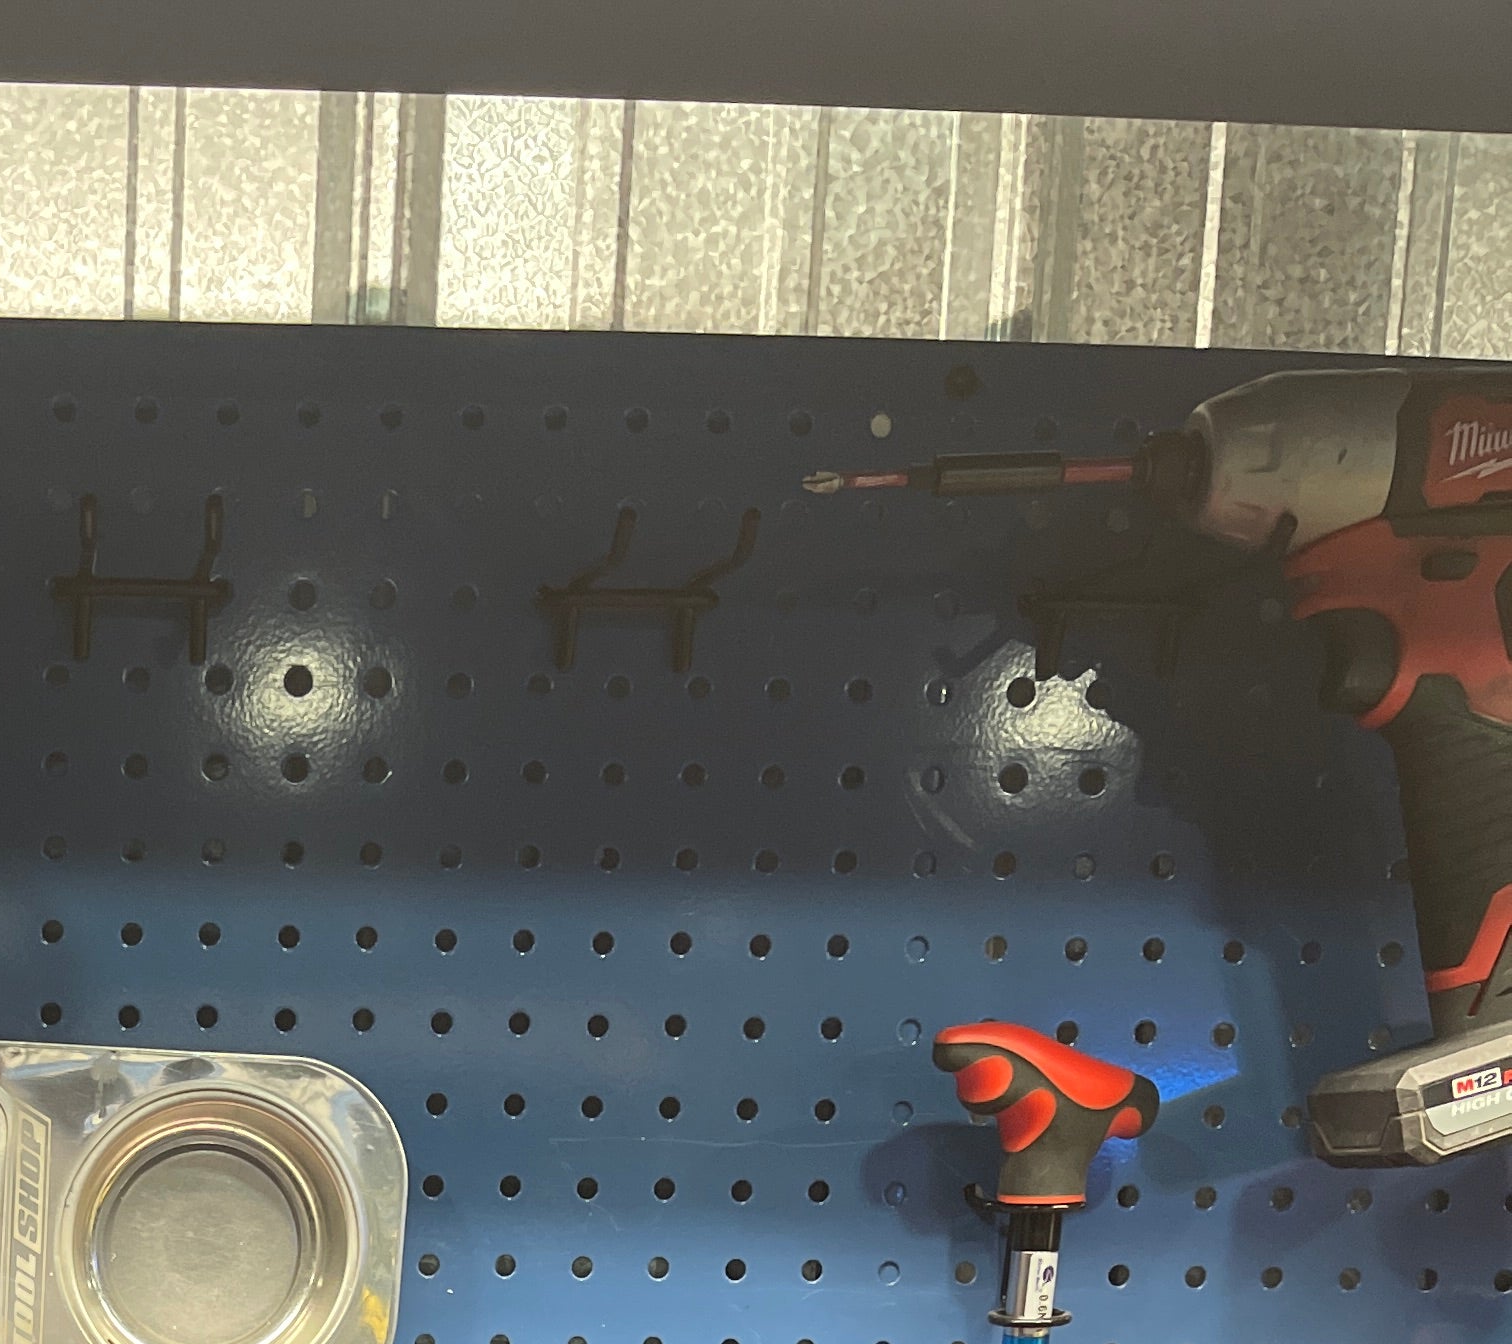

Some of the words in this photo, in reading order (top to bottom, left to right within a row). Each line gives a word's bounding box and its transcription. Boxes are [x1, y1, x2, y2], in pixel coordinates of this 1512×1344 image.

[1457, 1073, 1497, 1093] M12
[1451, 1092, 1500, 1117] HIGH
[19, 1118, 41, 1243] SHOP
